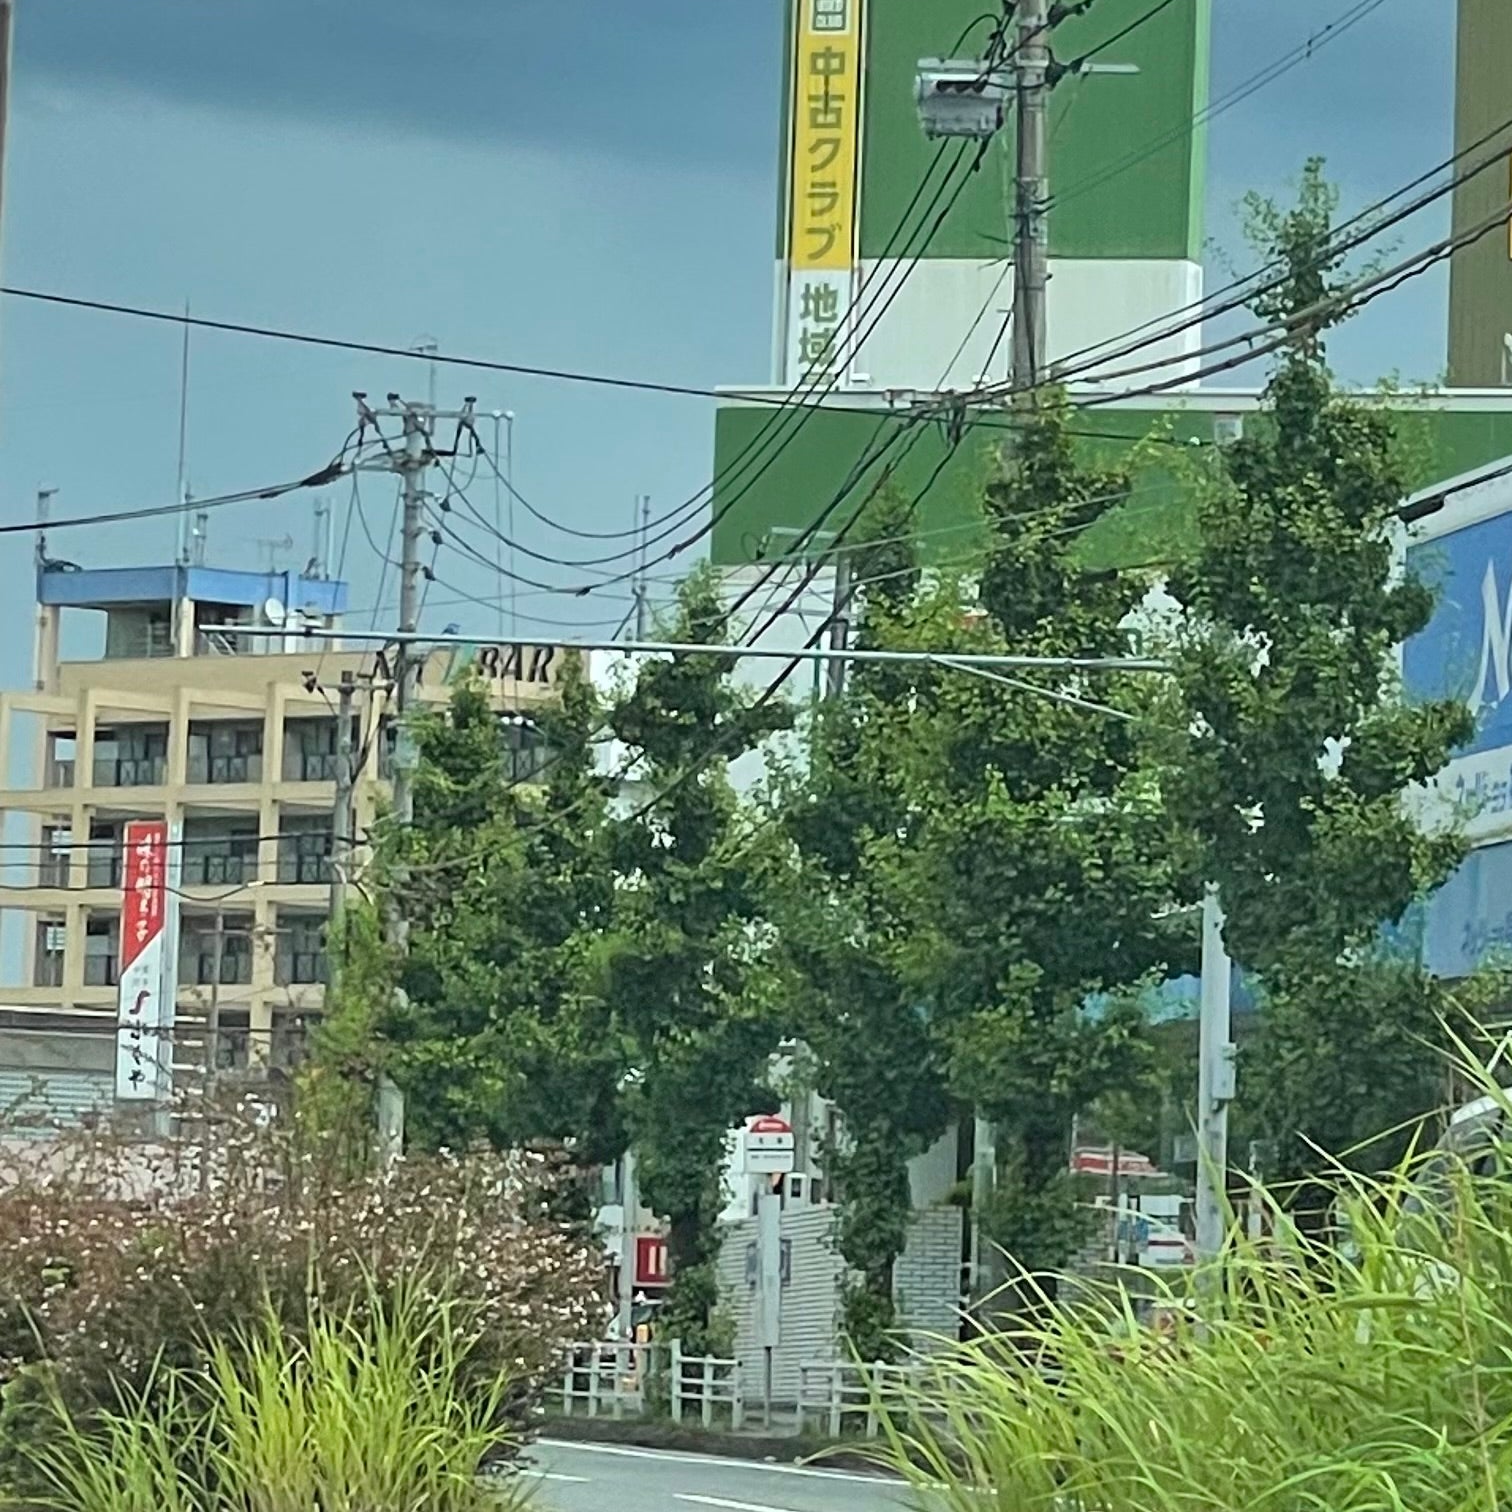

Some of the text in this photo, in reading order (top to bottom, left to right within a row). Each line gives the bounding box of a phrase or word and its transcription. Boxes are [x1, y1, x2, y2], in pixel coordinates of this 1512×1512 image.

[806, 45, 846, 262] 中古クラブ
[798, 282, 838, 385] 地域
